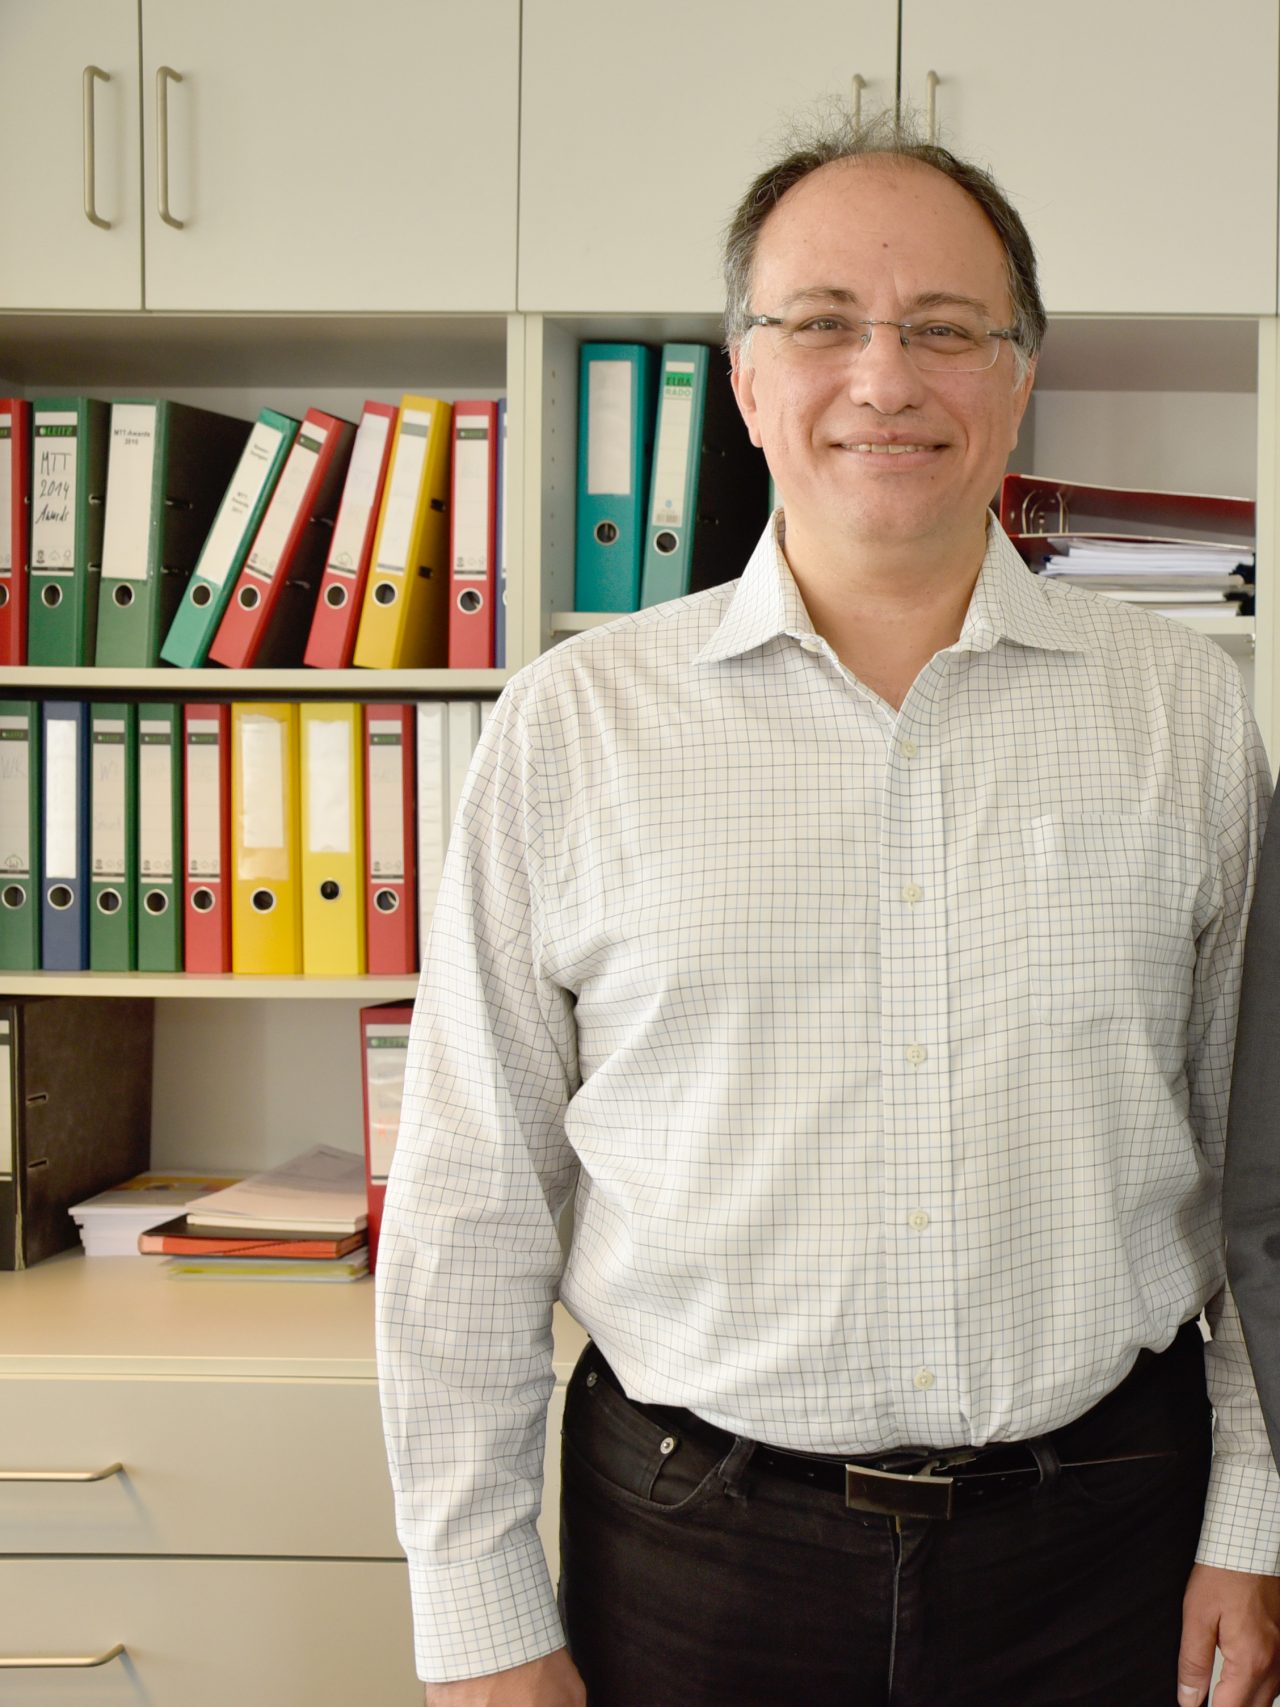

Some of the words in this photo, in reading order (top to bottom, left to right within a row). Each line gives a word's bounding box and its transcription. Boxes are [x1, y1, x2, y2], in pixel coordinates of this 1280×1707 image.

[47, 426, 73, 436] LEITZ
[41, 451, 72, 476] MTT
[40, 479, 70, 500] 2014
